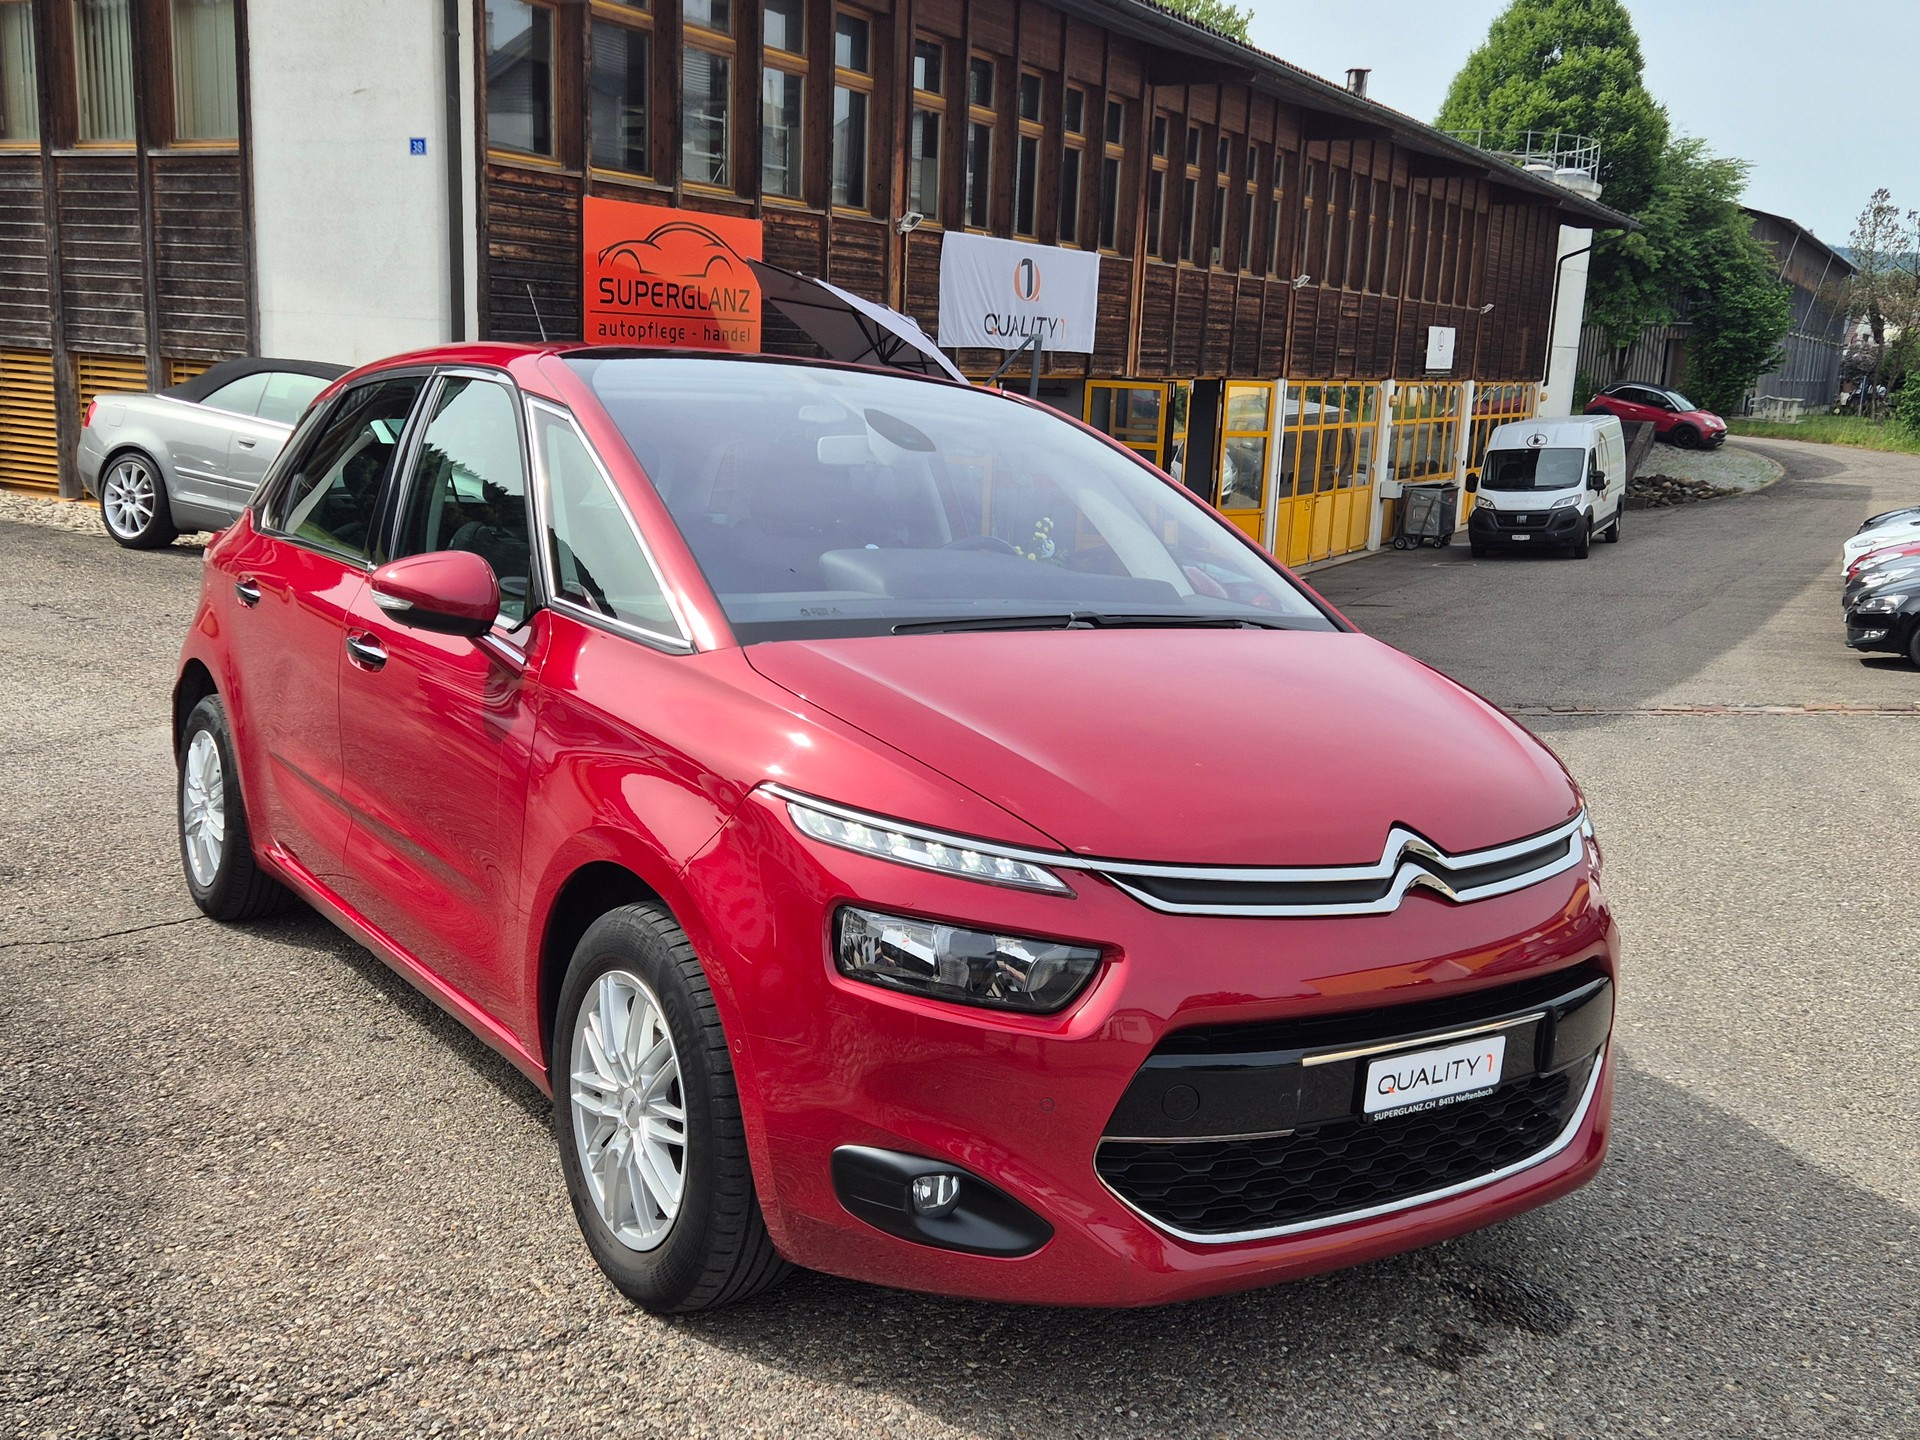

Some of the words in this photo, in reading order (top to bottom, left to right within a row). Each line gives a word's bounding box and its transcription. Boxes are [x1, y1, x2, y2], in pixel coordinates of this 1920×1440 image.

[412, 140, 424, 153] 38
[598, 278, 750, 313] SUPERGLANZ
[598, 322, 686, 343] autopflege
[703, 328, 751, 343] handel
[984, 313, 1058, 338] QUALITY
[1060, 318, 1067, 339] 1
[1378, 1055, 1481, 1095] QUALITY
[1486, 1053, 1494, 1072] 1
[1374, 1101, 1436, 1122] SUPERGLANZ.CH
[1438, 1096, 1455, 1107] 8413
[1455, 1087, 1493, 1102] Neftenbach
